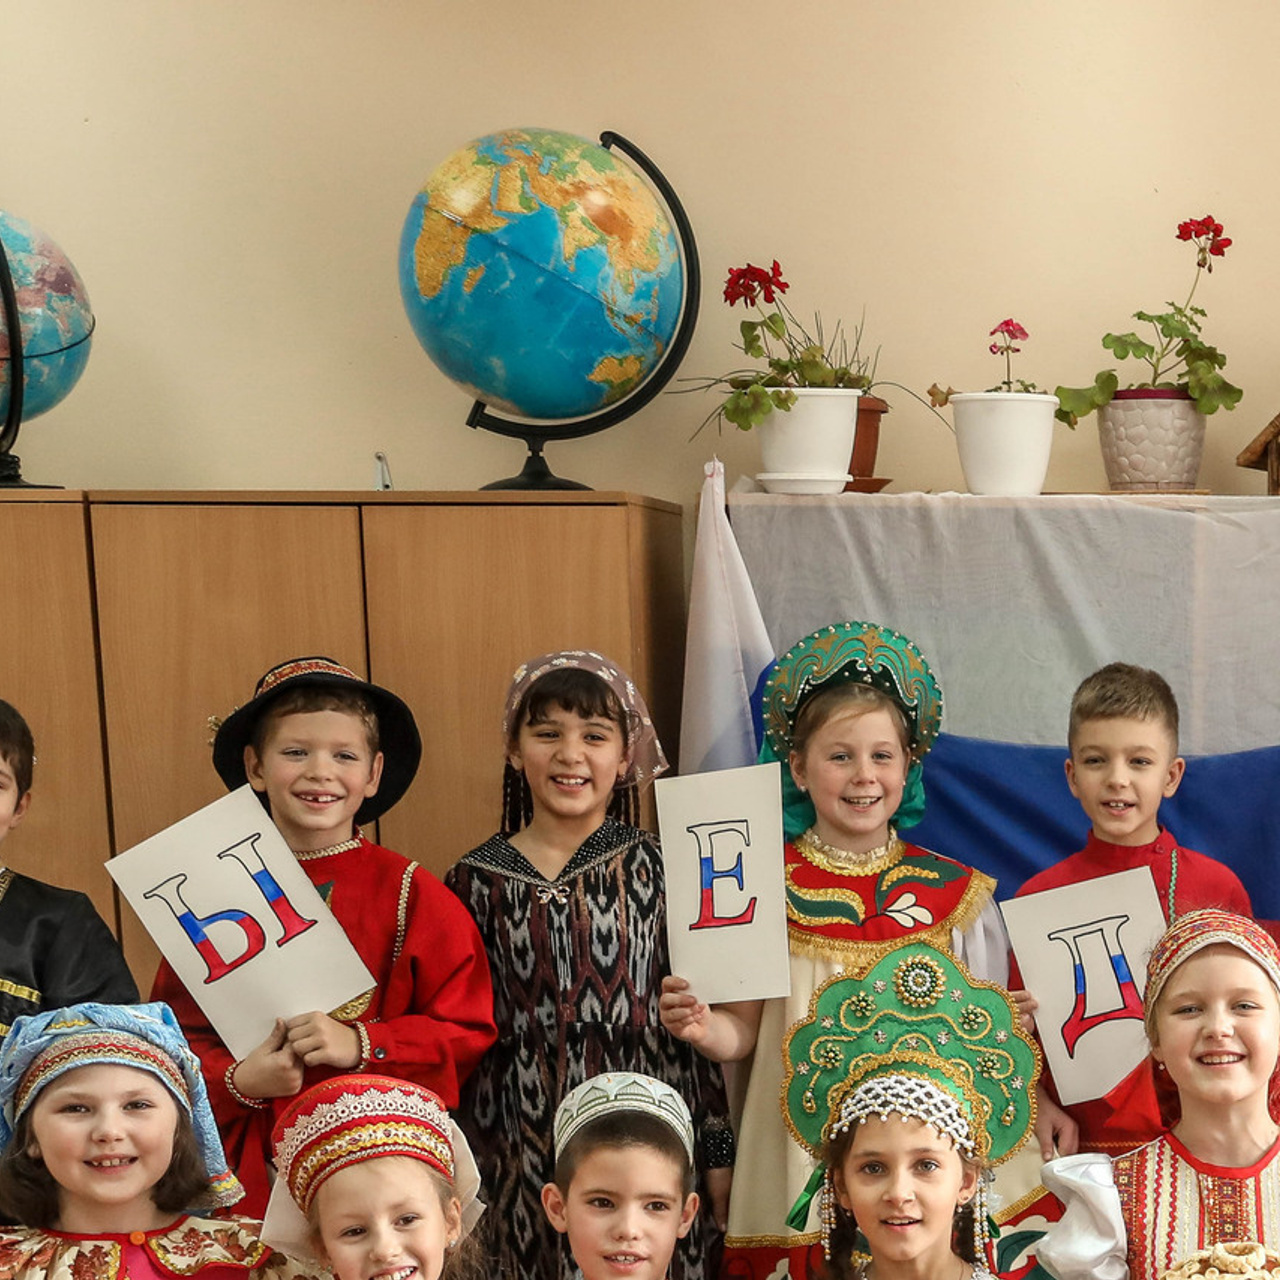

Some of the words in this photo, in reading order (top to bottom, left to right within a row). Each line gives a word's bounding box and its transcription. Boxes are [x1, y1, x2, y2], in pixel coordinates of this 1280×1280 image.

[143, 832, 318, 985] Ы
[686, 819, 757, 931] Е
[1048, 914, 1146, 1060] Д
